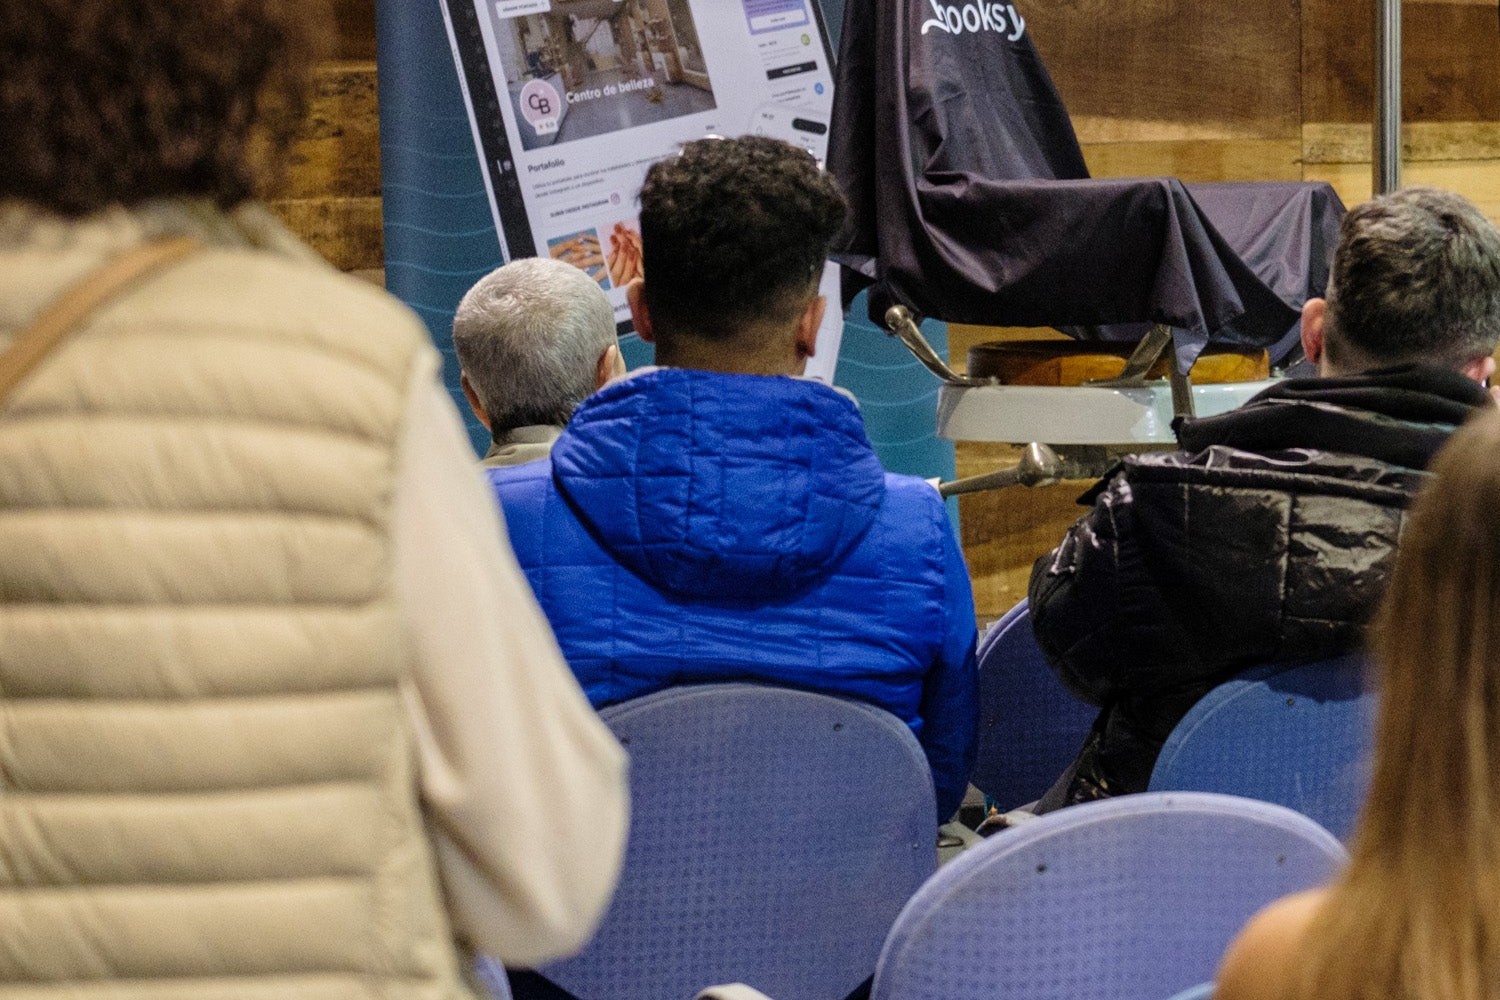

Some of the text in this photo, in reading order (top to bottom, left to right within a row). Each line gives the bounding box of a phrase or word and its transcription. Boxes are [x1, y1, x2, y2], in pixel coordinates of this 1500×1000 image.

[565, 76, 655, 104] Centro de belleza
[527, 157, 566, 173] Portafolio
